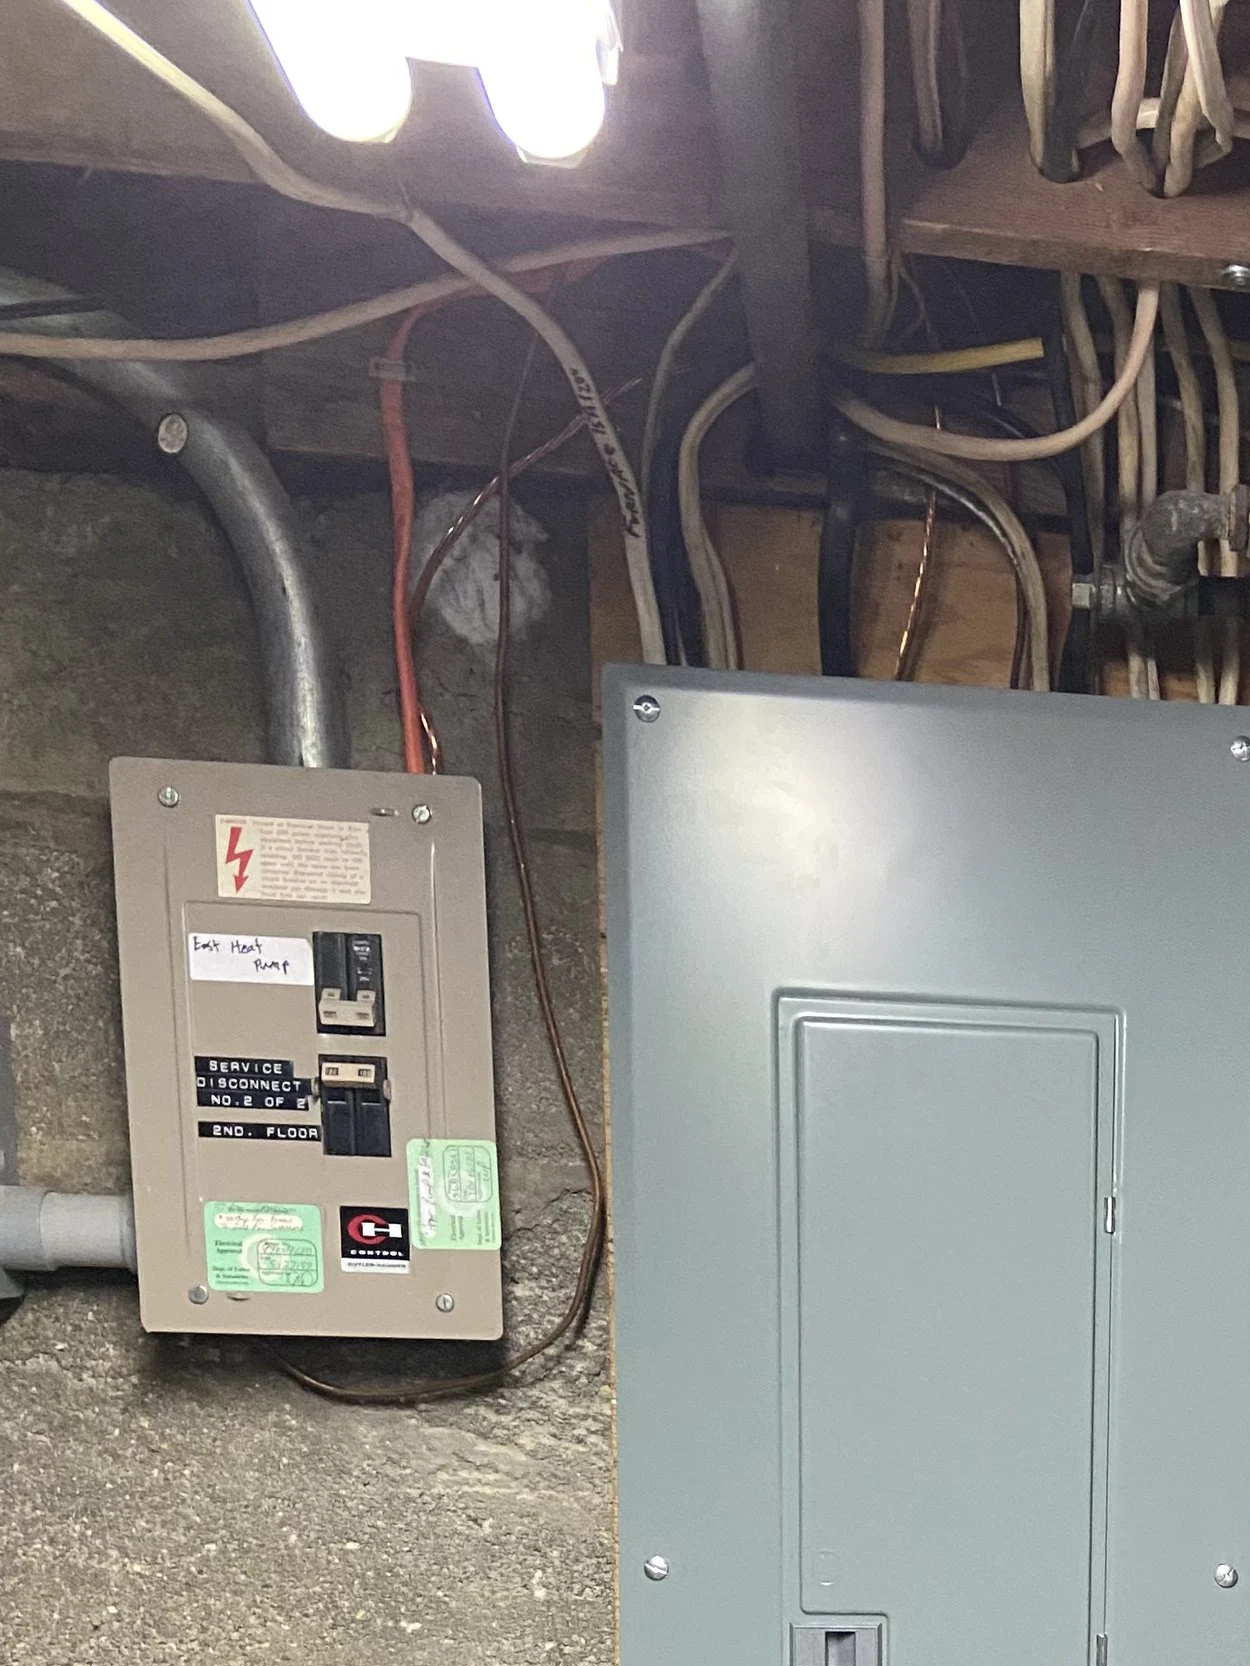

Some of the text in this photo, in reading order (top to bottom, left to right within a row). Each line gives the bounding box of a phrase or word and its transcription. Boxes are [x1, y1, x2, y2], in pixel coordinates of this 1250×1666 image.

[193, 936, 263, 954] East Heat
[254, 958, 290, 975] Pump
[209, 1060, 282, 1074] SERVICE
[196, 1076, 301, 1092] DISCONNECT
[264, 1097, 284, 1107] OF
[296, 1098, 306, 1109] 2
[212, 1125, 319, 1138] 2ND. FLOOR
